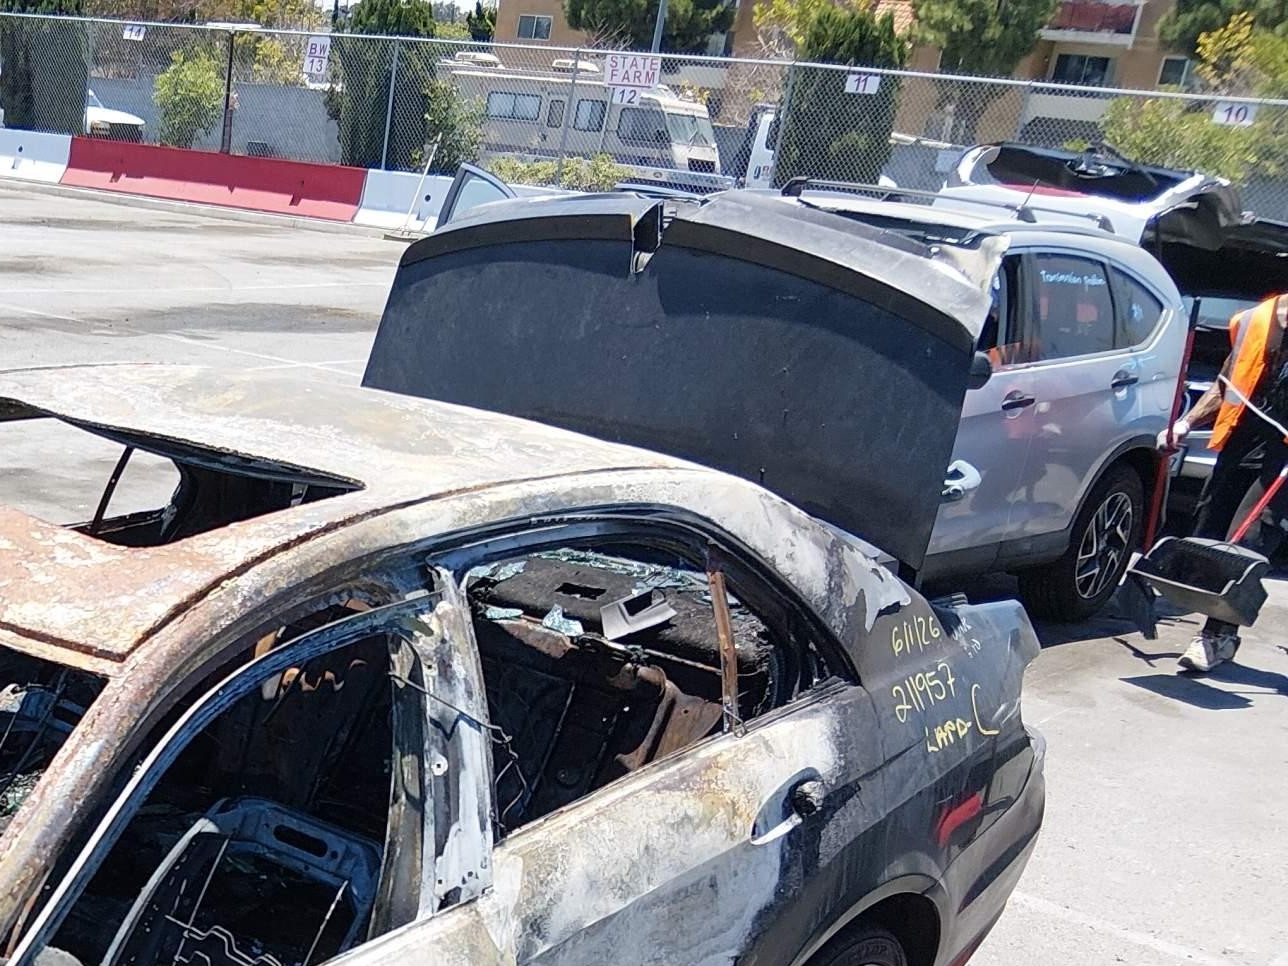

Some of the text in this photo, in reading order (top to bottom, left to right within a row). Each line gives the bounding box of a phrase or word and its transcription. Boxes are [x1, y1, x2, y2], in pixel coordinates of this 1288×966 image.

[309, 43, 328, 56] BW
[309, 58, 324, 73] 13
[609, 55, 659, 71] STATE
[610, 69, 656, 84] FARM
[854, 75, 869, 92] 11
[619, 88, 638, 105] 12
[1224, 104, 1248, 123] 10
[892, 662, 956, 724] 211957
